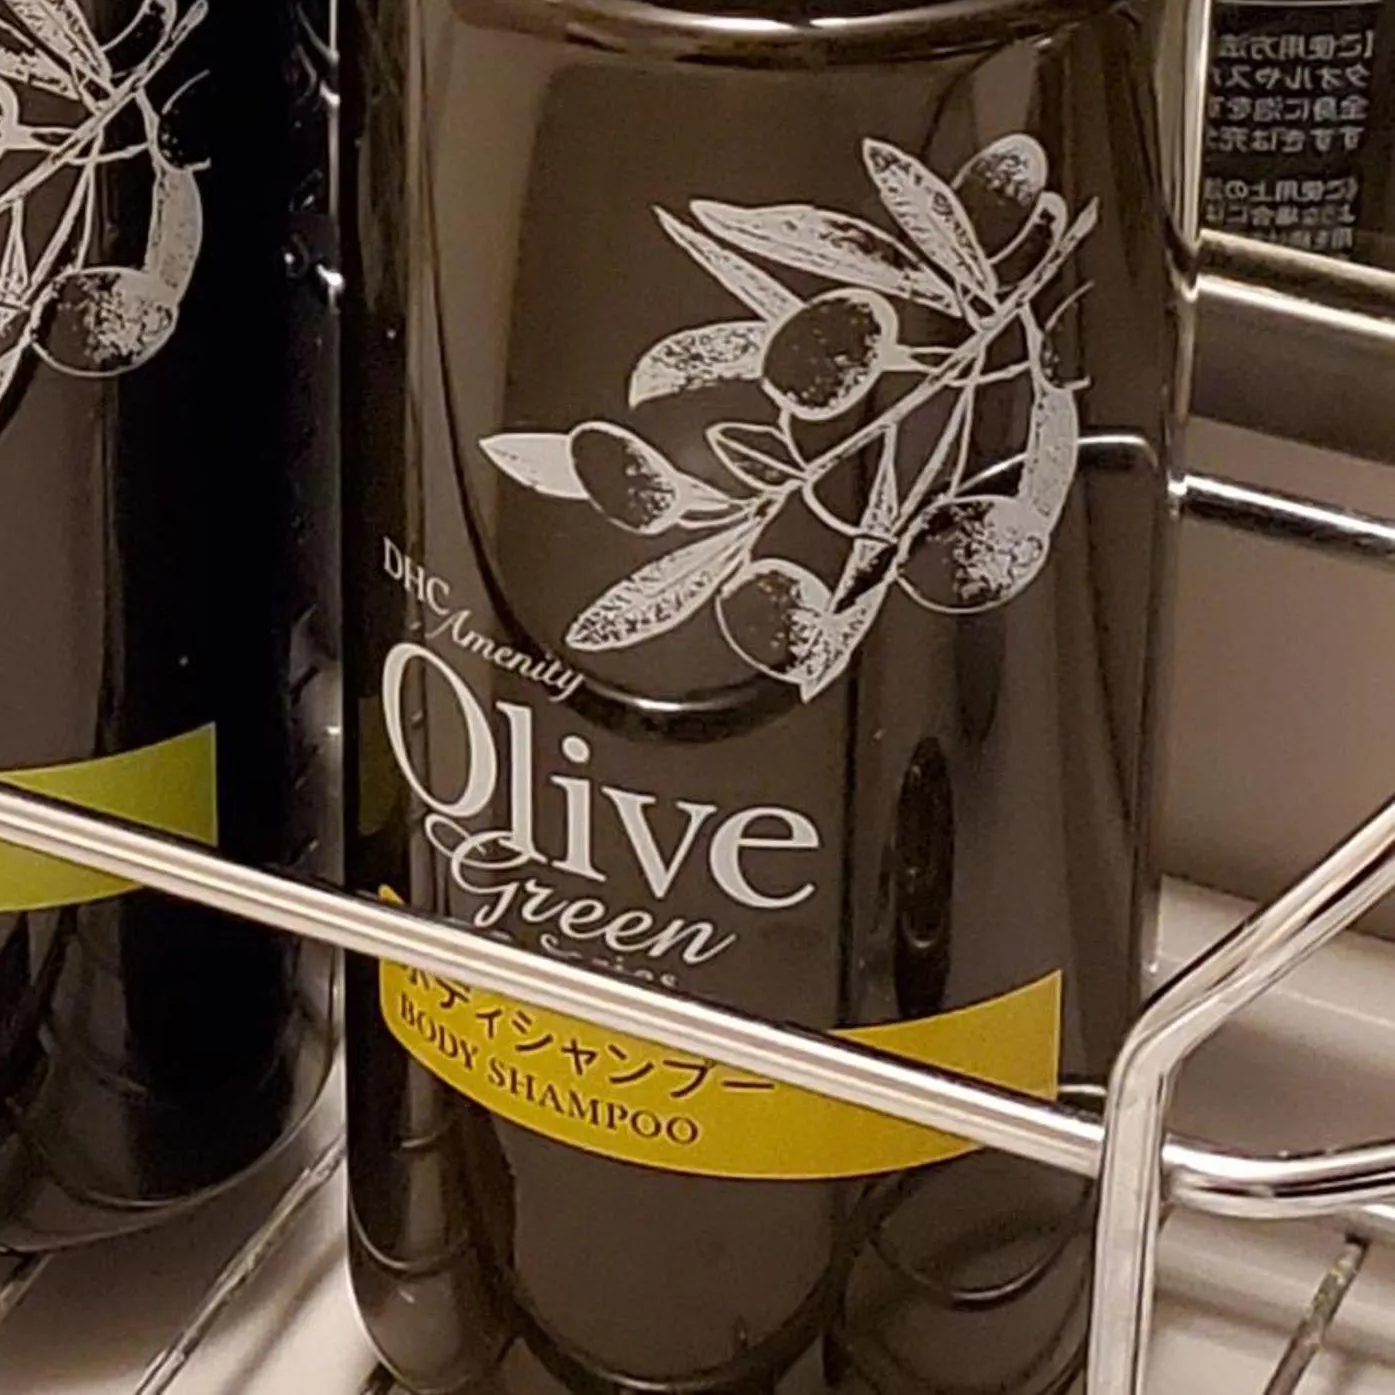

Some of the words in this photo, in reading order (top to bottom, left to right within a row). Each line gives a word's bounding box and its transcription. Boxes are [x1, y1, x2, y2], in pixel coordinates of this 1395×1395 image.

[382, 536, 451, 616] DHC
[425, 609, 586, 702] Amenity
[381, 642, 820, 908] Olive
[423, 814, 737, 965] Green
[400, 992, 480, 1071] BODY
[487, 1057, 700, 1146] SHAMPOO
